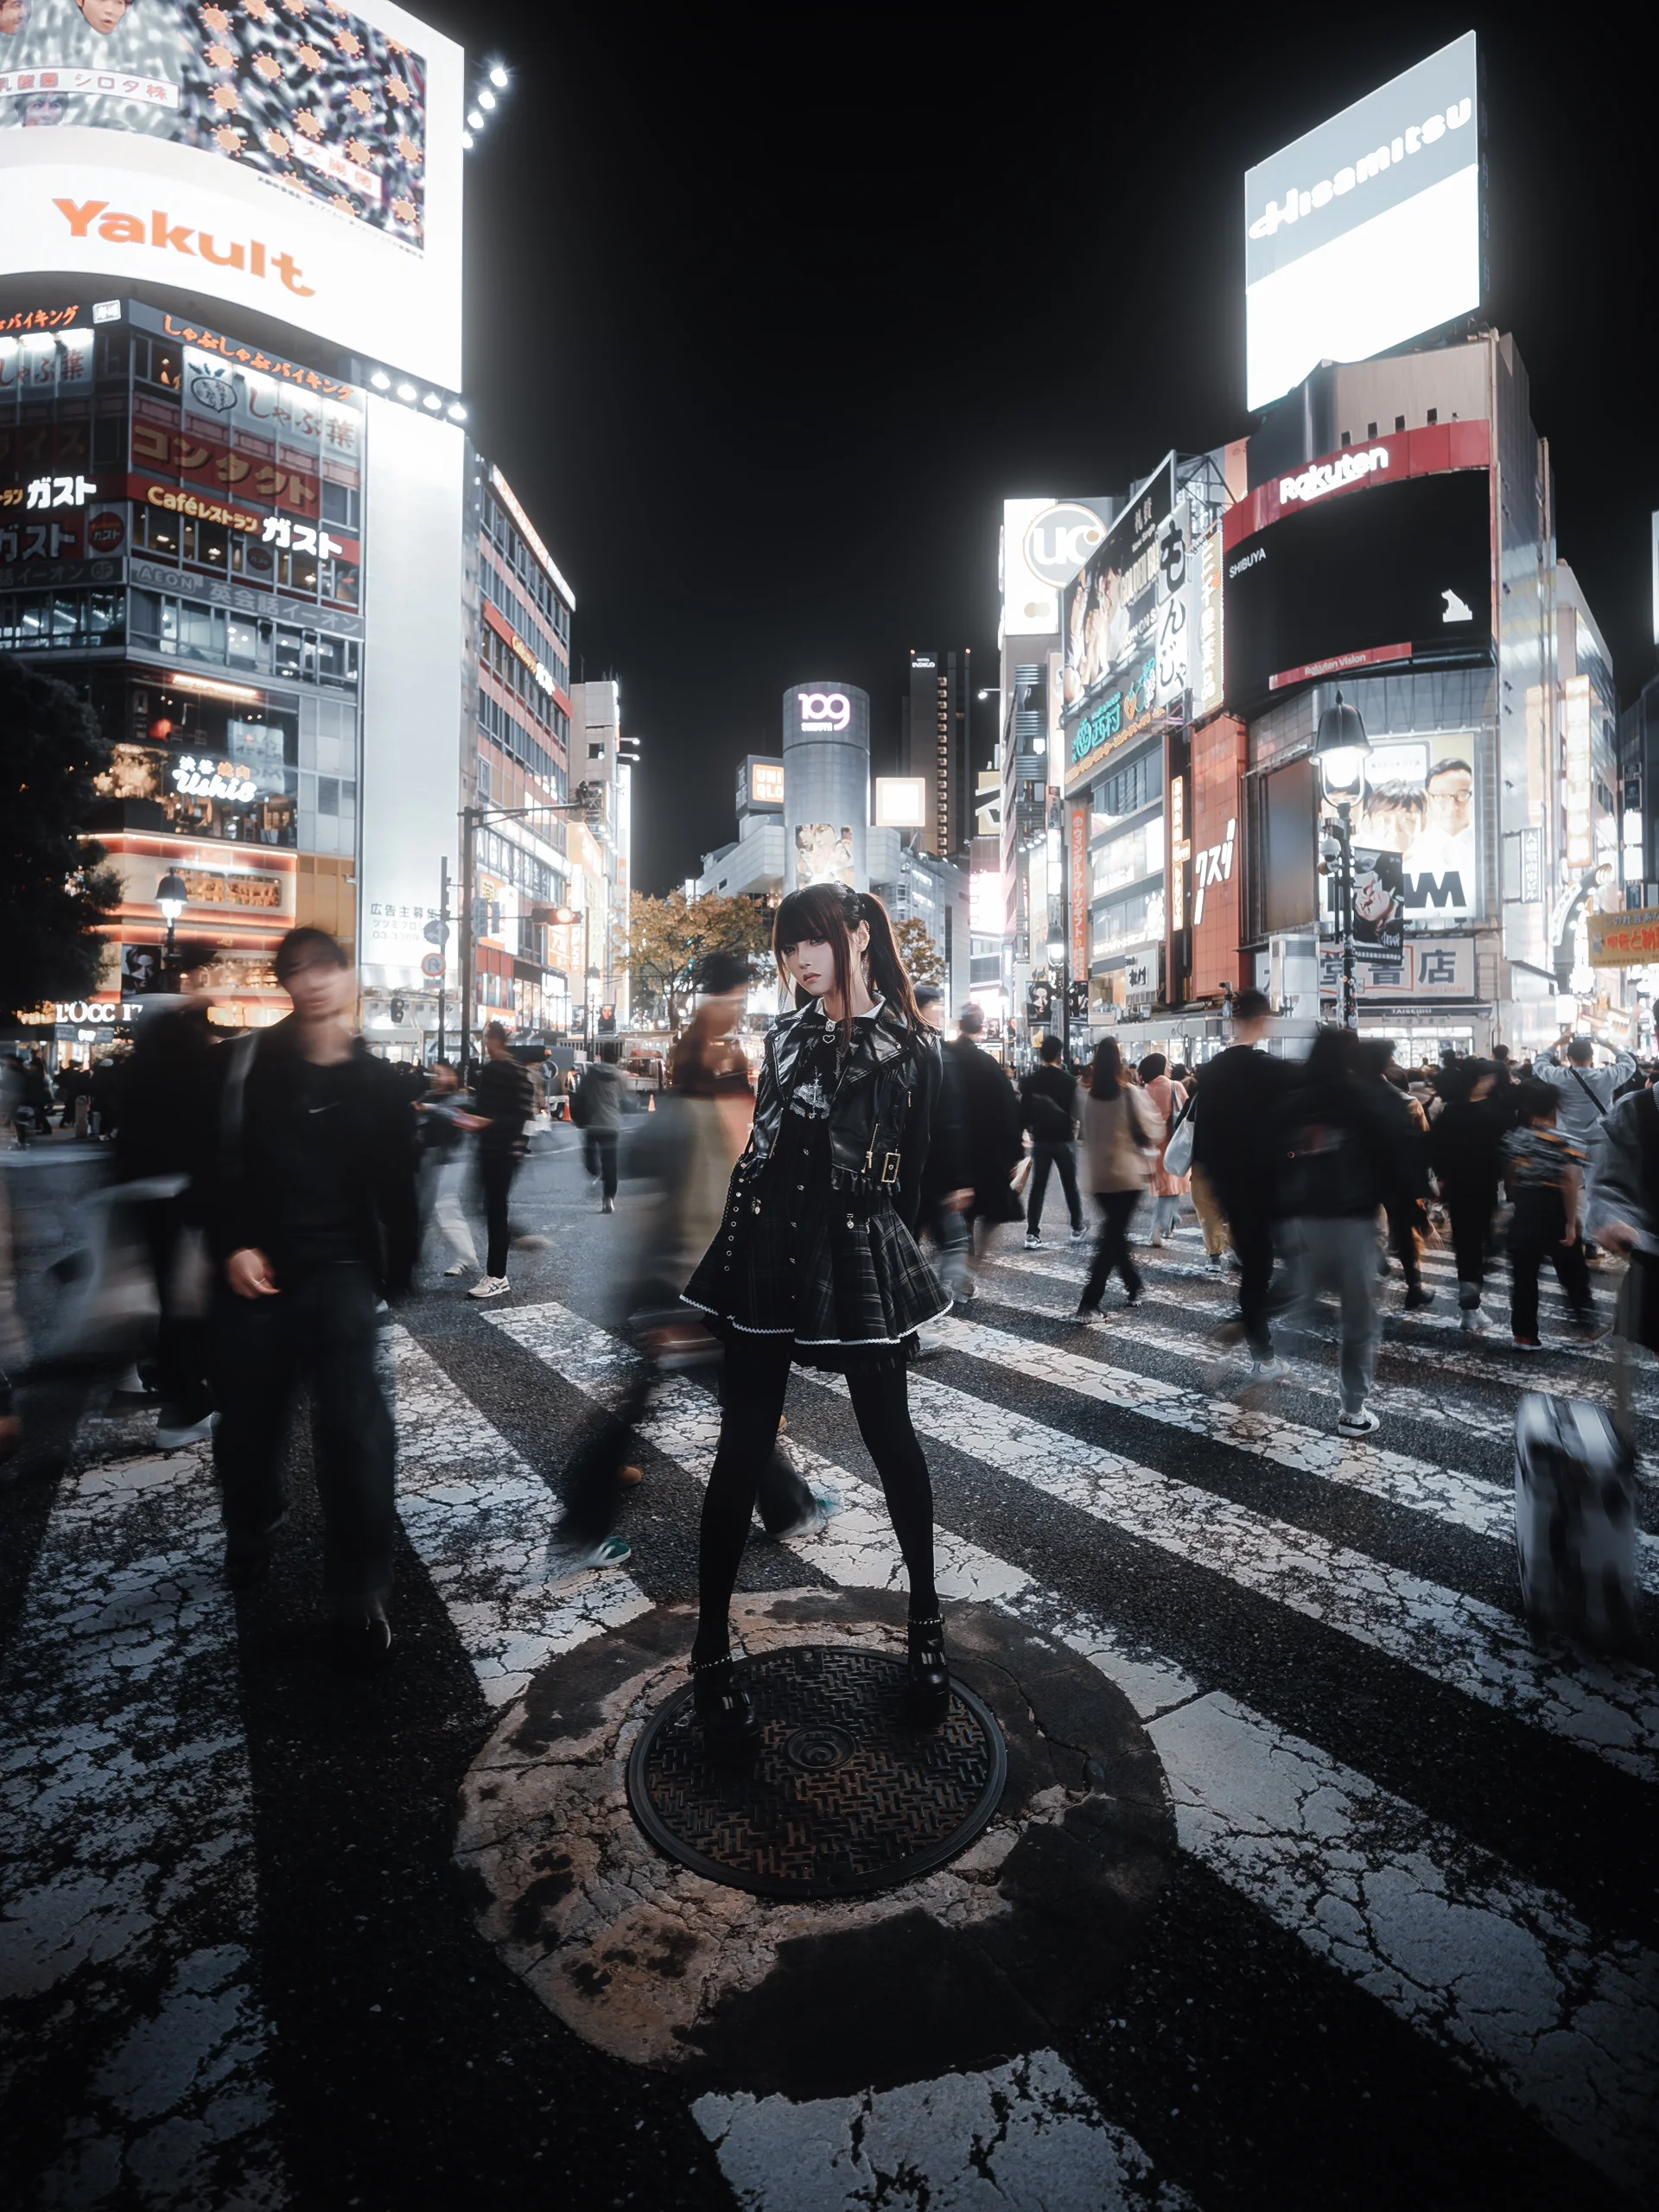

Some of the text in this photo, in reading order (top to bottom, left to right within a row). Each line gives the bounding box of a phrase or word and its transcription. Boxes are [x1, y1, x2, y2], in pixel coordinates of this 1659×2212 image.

[53, 198, 316, 297] Yakult
[163, 314, 355, 401] しゃぶしゃぶバイキング
[248, 386, 356, 450] しゃぶ葉
[132, 423, 317, 505] コンタクト
[1280, 445, 1389, 504] Rakuten
[27, 475, 97, 510] ガスト
[0, 523, 75, 562] ガスト
[93, 529, 120, 542] ガスト
[262, 516, 342, 559] ガスト
[1229, 547, 1267, 579] SHIBUYA
[139, 567, 359, 632] AEON 英会話イーオン
[1159, 518, 1187, 688] もんじゃ
[1305, 652, 1367, 677] Rakuten Vision
[798, 694, 850, 731] 109
[756, 768, 782, 784] UNI
